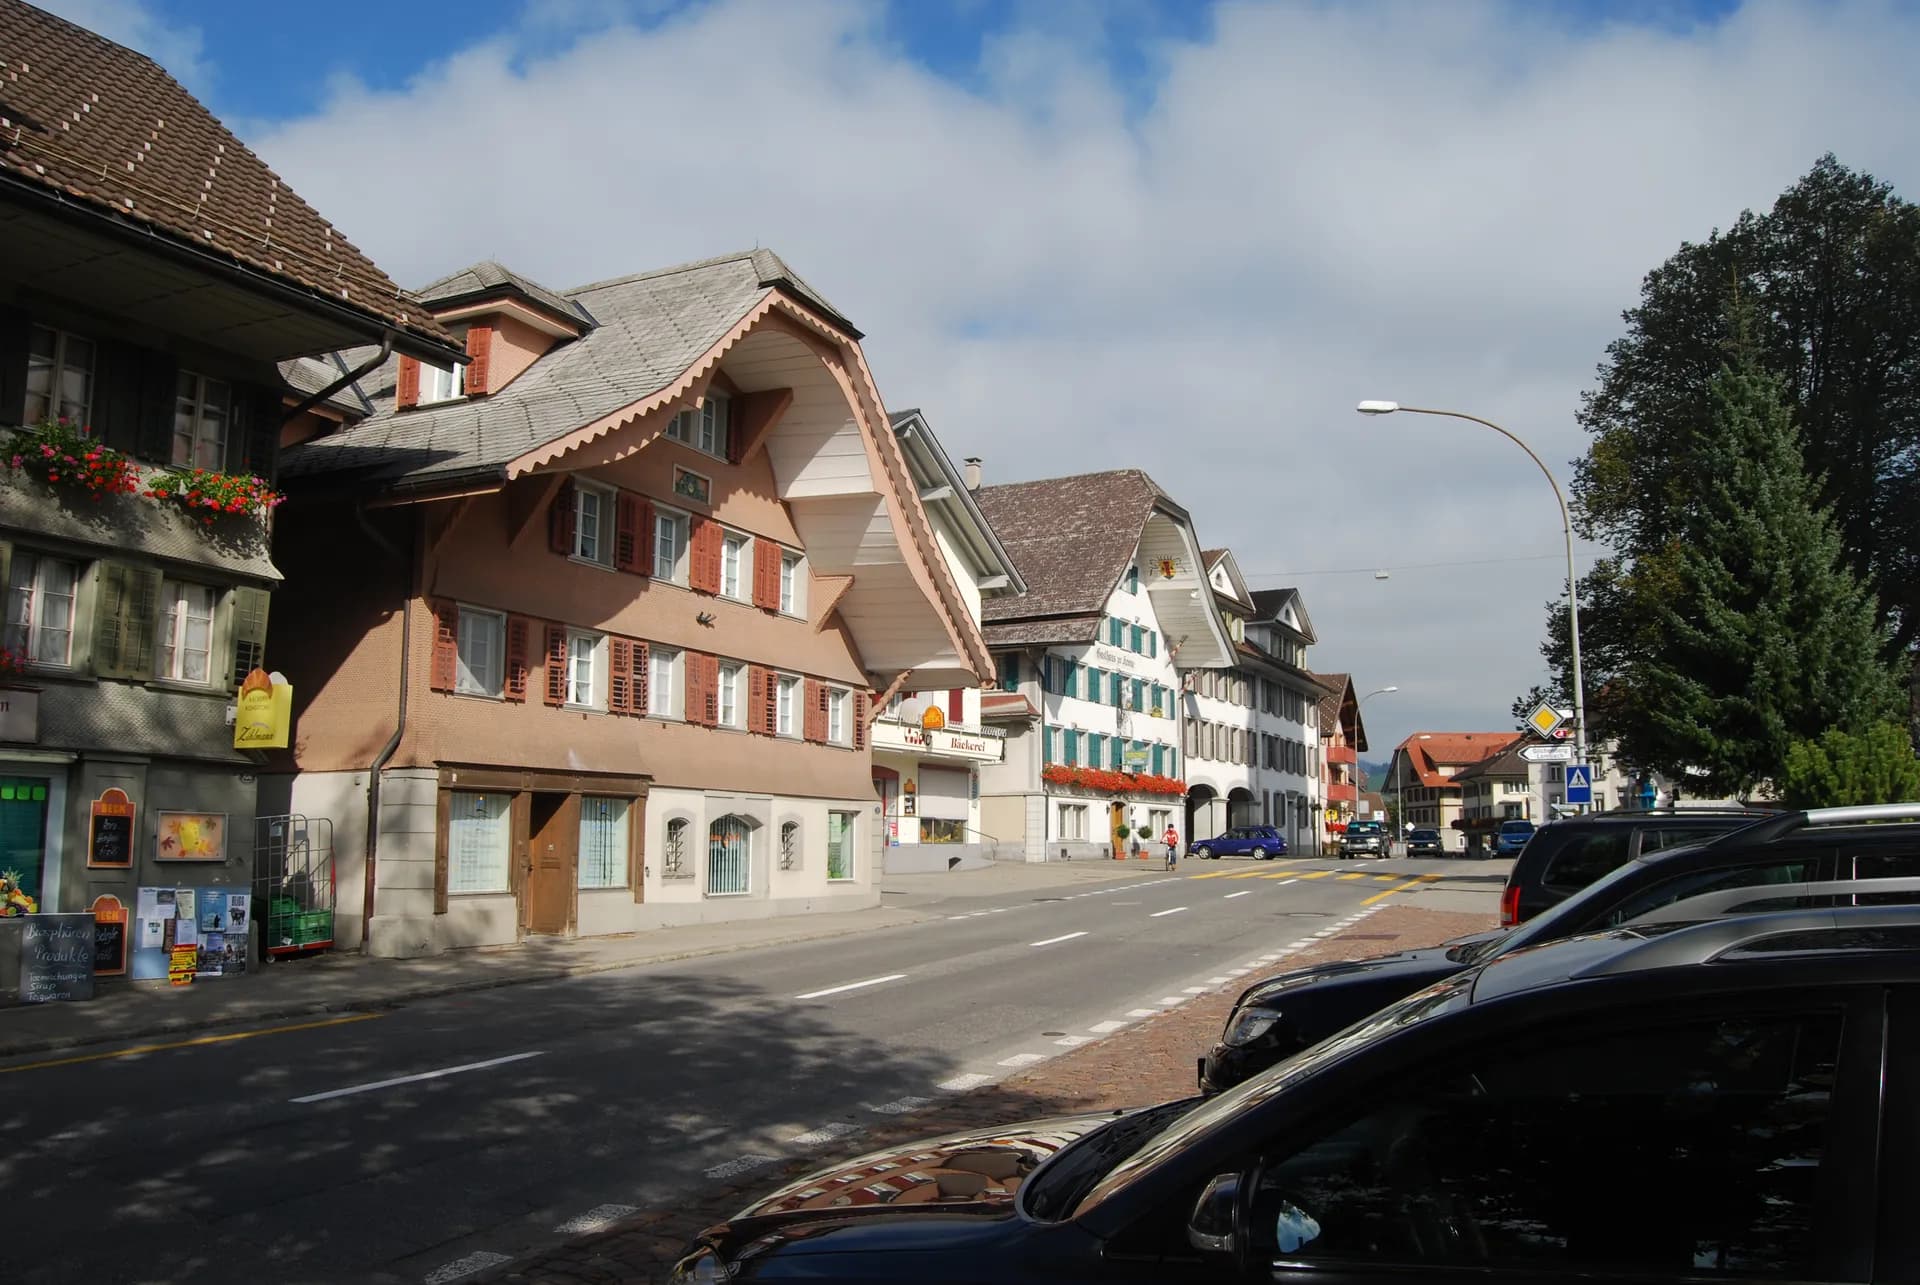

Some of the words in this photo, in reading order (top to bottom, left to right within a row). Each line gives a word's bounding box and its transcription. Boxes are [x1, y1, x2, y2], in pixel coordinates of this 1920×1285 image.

[951, 737, 986, 752] Bäckerei
[101, 803, 126, 814] BECK
[34, 944, 89, 962] Produkte
